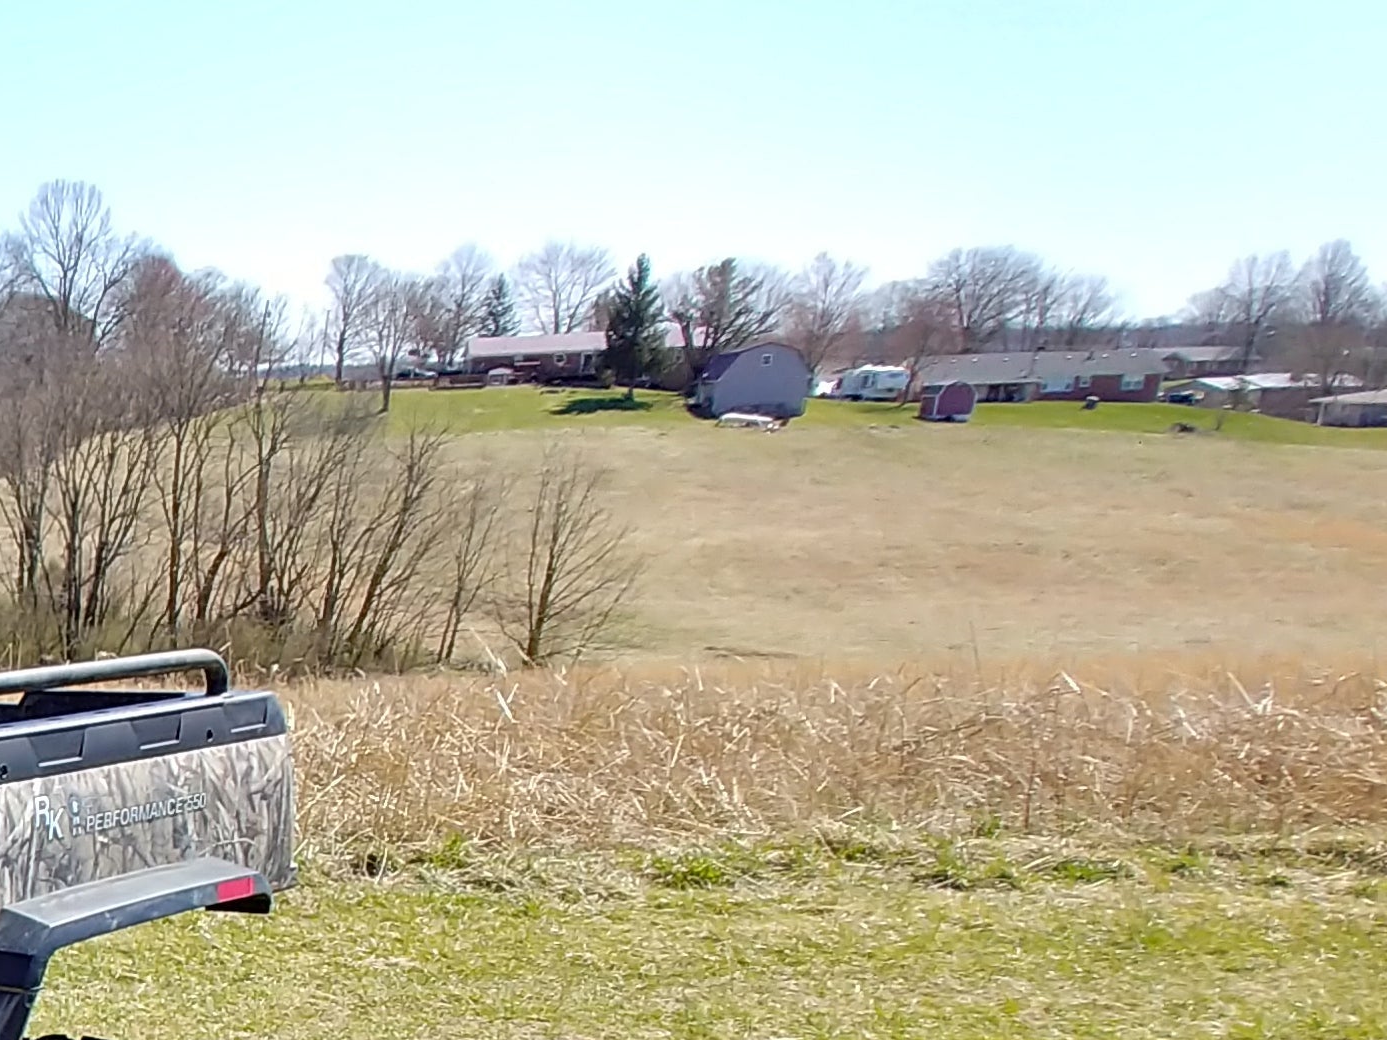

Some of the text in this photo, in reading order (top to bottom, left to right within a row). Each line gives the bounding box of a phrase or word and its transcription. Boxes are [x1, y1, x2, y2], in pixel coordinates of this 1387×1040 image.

[34, 792, 207, 840] RK PERFORMANCE 550
